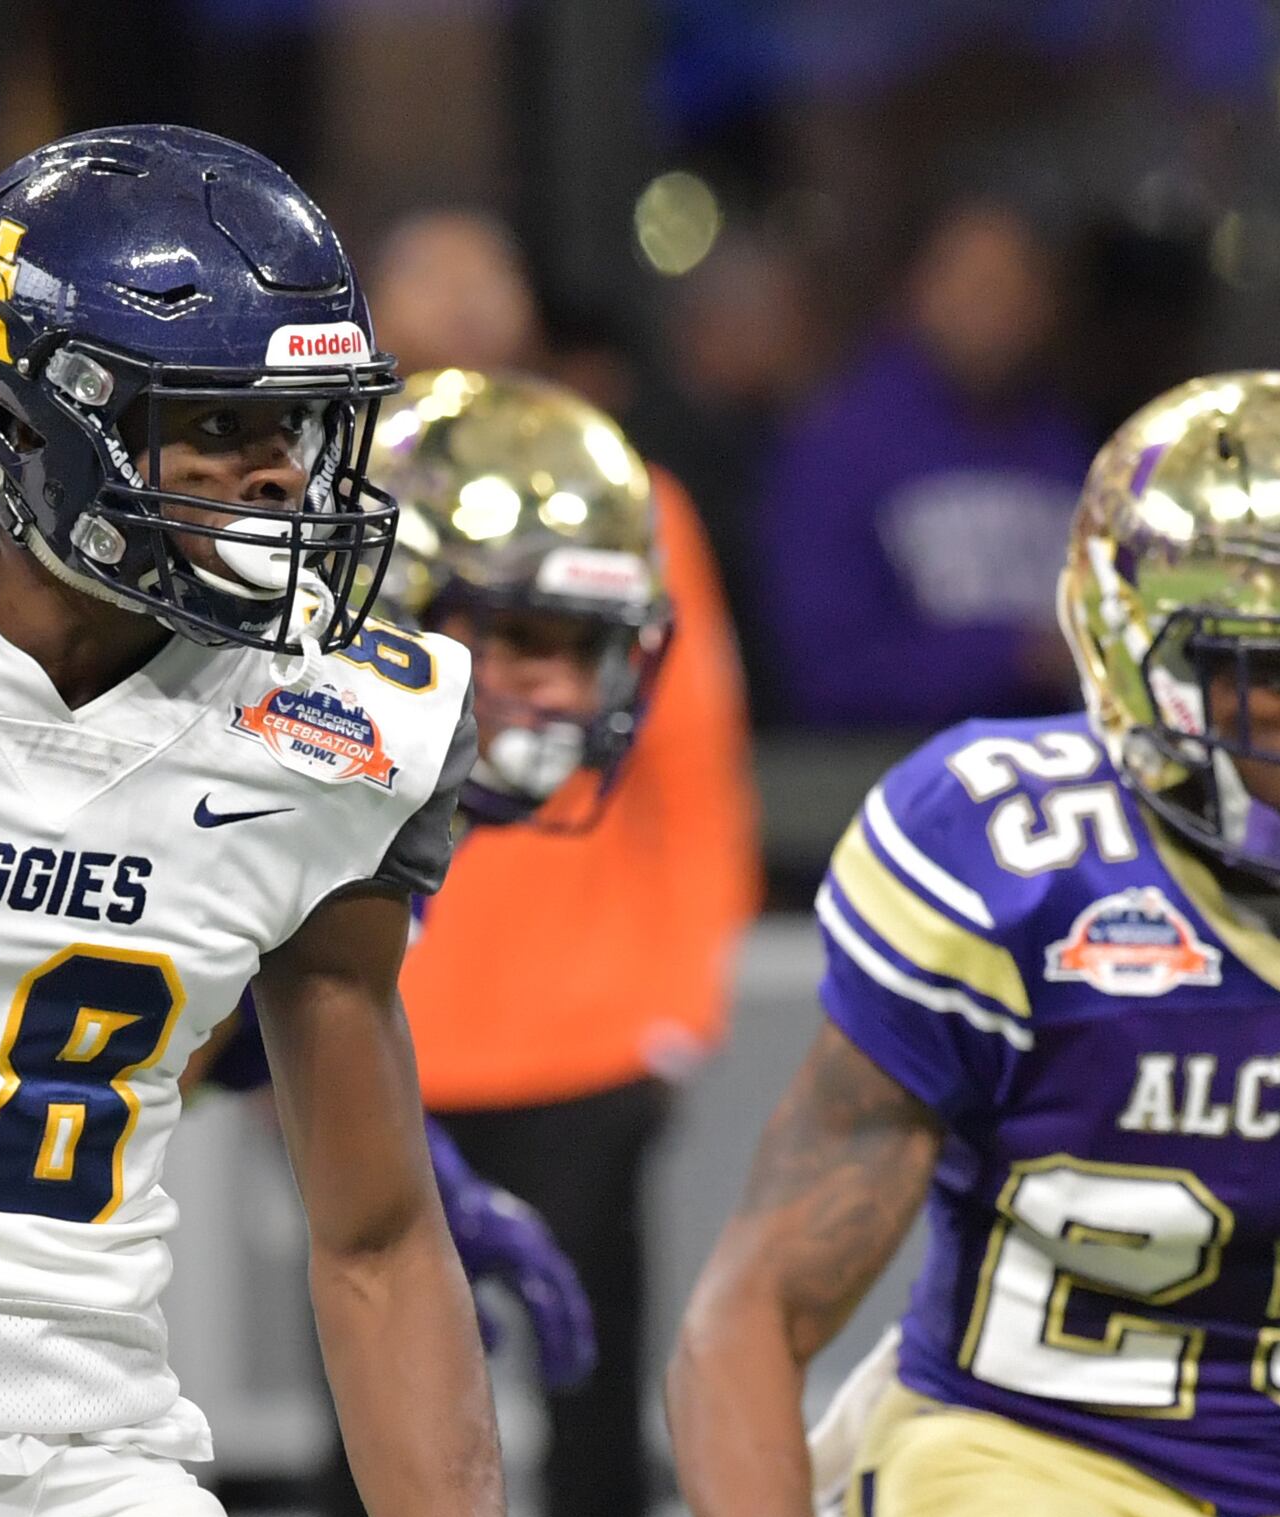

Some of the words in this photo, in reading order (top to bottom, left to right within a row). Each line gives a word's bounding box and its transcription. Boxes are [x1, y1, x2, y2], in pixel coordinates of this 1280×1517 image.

[288, 331, 362, 357] Riddell
[295, 703, 321, 719] AIR
[322, 710, 371, 735] FORCE
[297, 711, 365, 741] RESERVE
[262, 714, 374, 762] CELEBRATION
[290, 739, 337, 766] BOWL
[948, 731, 1138, 878] 25
